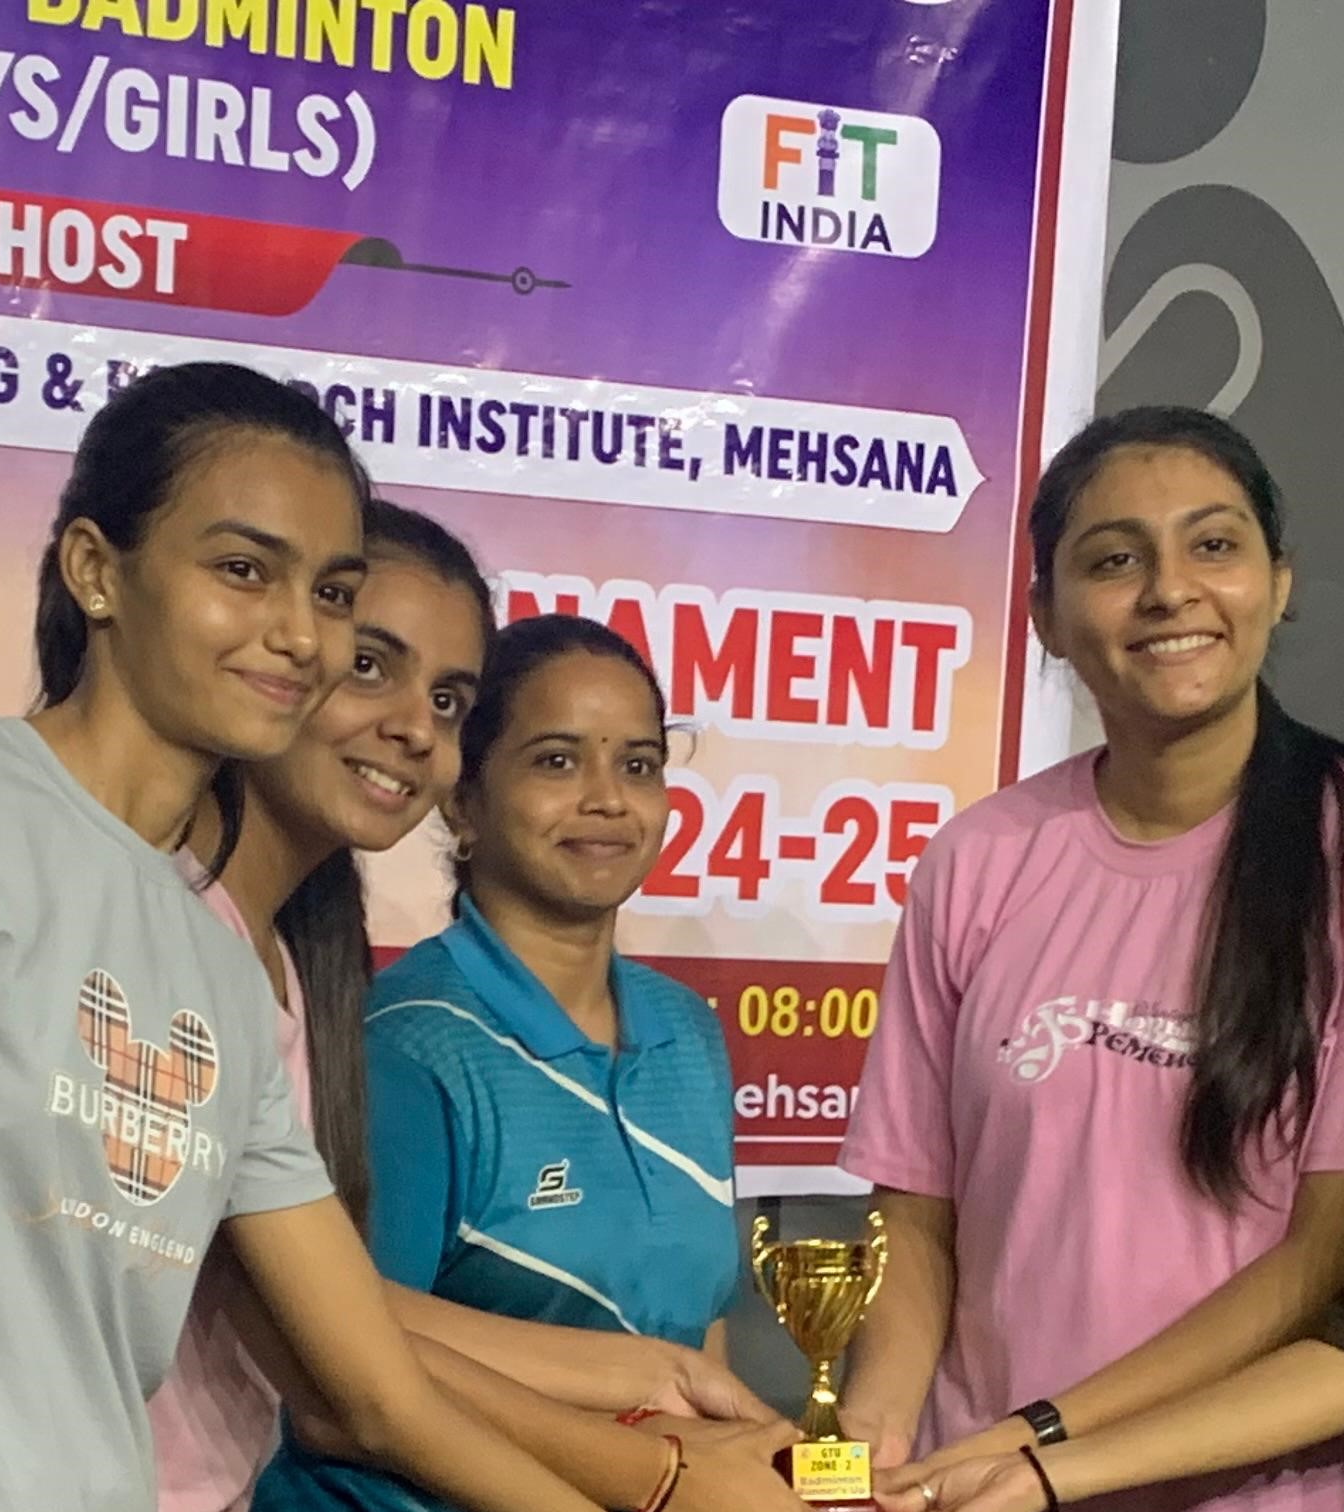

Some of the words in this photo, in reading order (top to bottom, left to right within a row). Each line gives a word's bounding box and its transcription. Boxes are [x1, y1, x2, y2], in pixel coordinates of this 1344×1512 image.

[760, 200, 893, 253] INDIA
[42, 352, 84, 411] &
[419, 391, 703, 482] INSTITUTE,
[723, 423, 960, 498] MEHSANA
[738, 985, 878, 1038] 08:00
